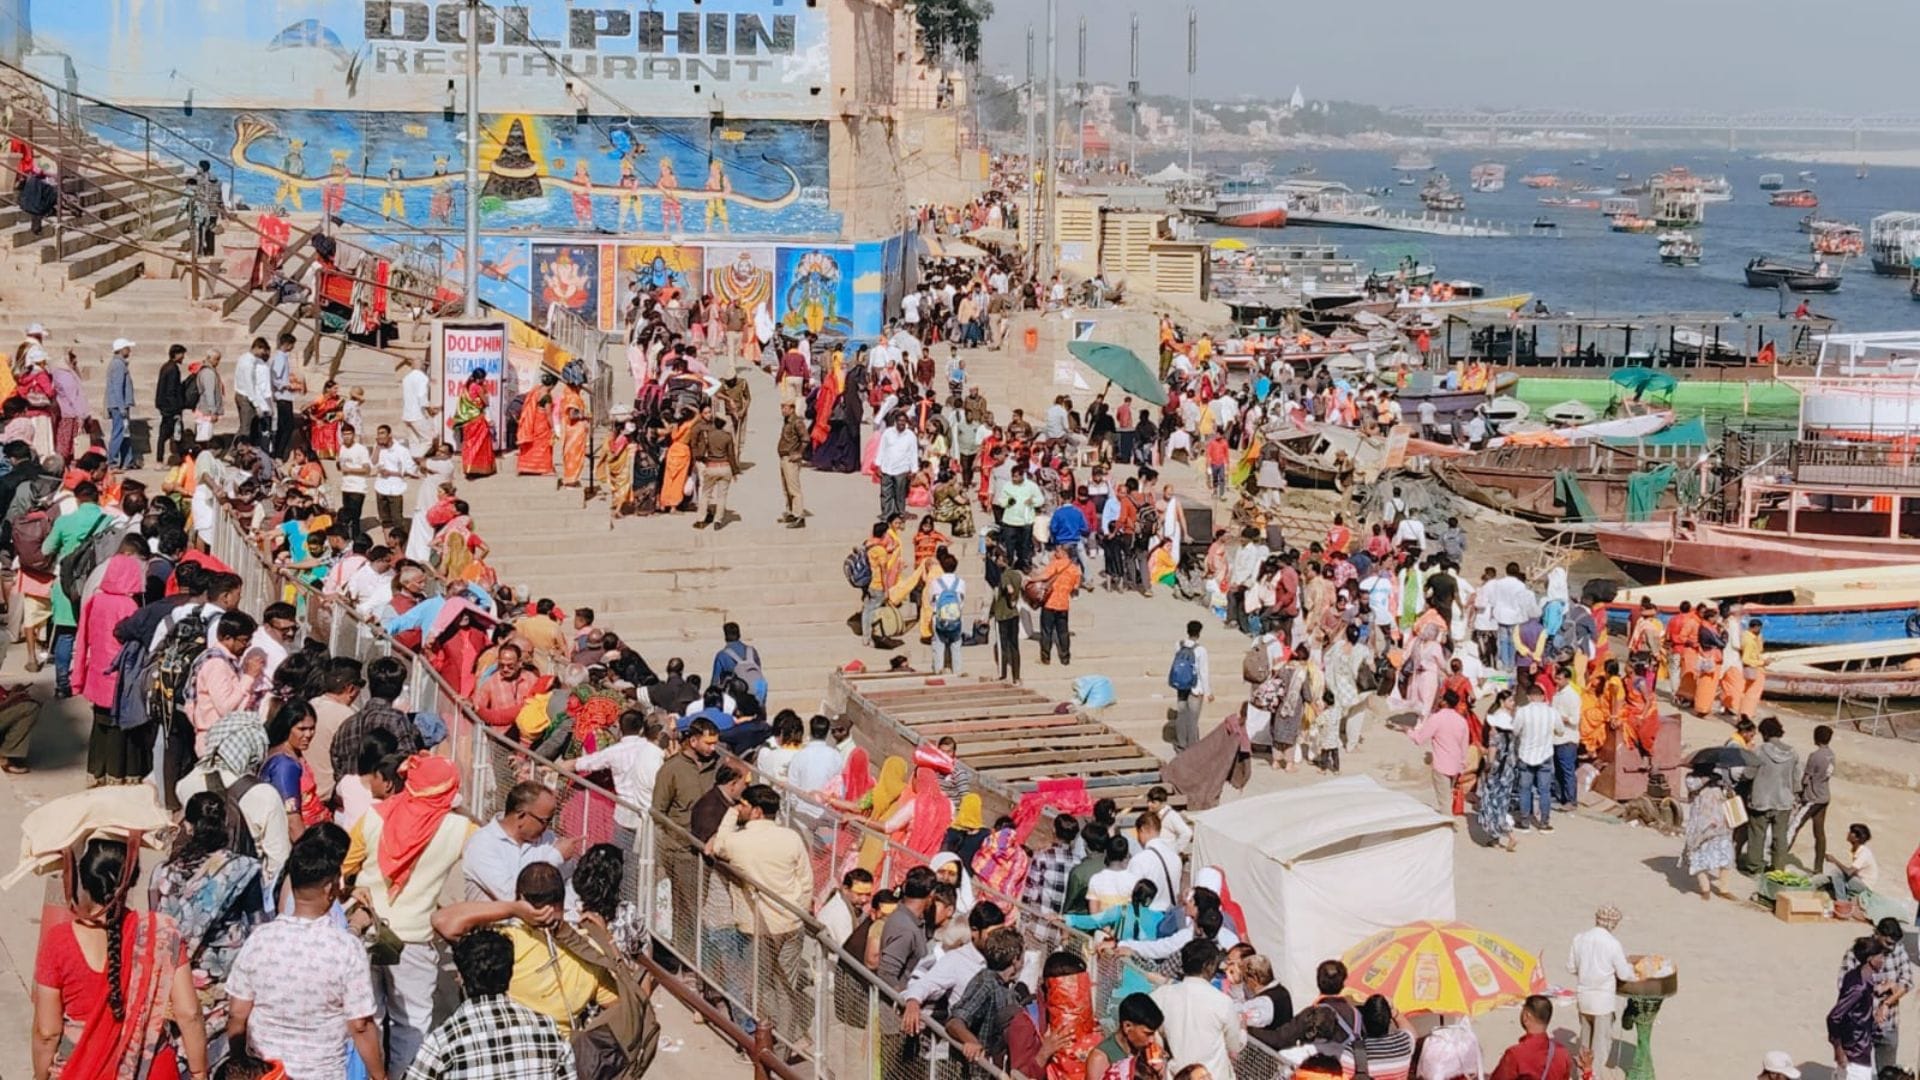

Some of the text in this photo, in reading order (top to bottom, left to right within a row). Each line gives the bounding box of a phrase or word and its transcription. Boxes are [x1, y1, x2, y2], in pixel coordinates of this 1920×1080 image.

[365, 1, 796, 55] DOLPHIN
[376, 47, 773, 81] RESTAURANT
[447, 334, 503, 352] DOLPHIN
